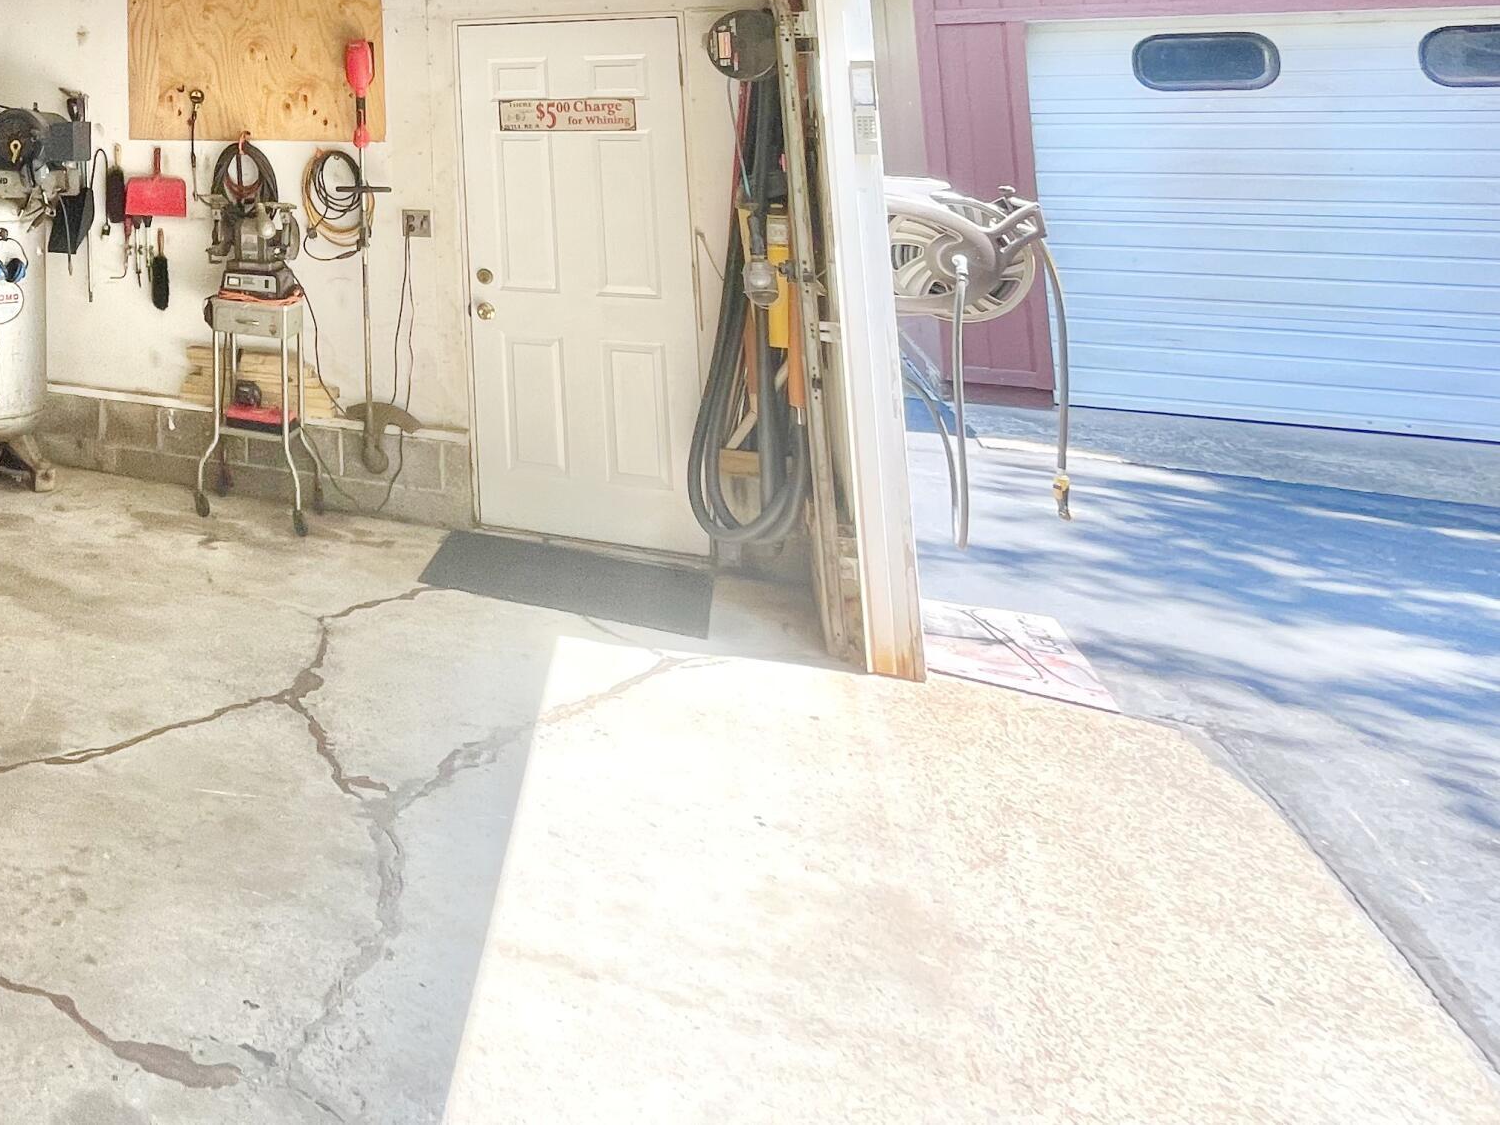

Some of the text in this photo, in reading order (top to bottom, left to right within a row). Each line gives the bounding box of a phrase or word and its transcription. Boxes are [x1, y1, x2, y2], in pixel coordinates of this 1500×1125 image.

[573, 100, 622, 115] Charge
[568, 116, 631, 127] for Whining
